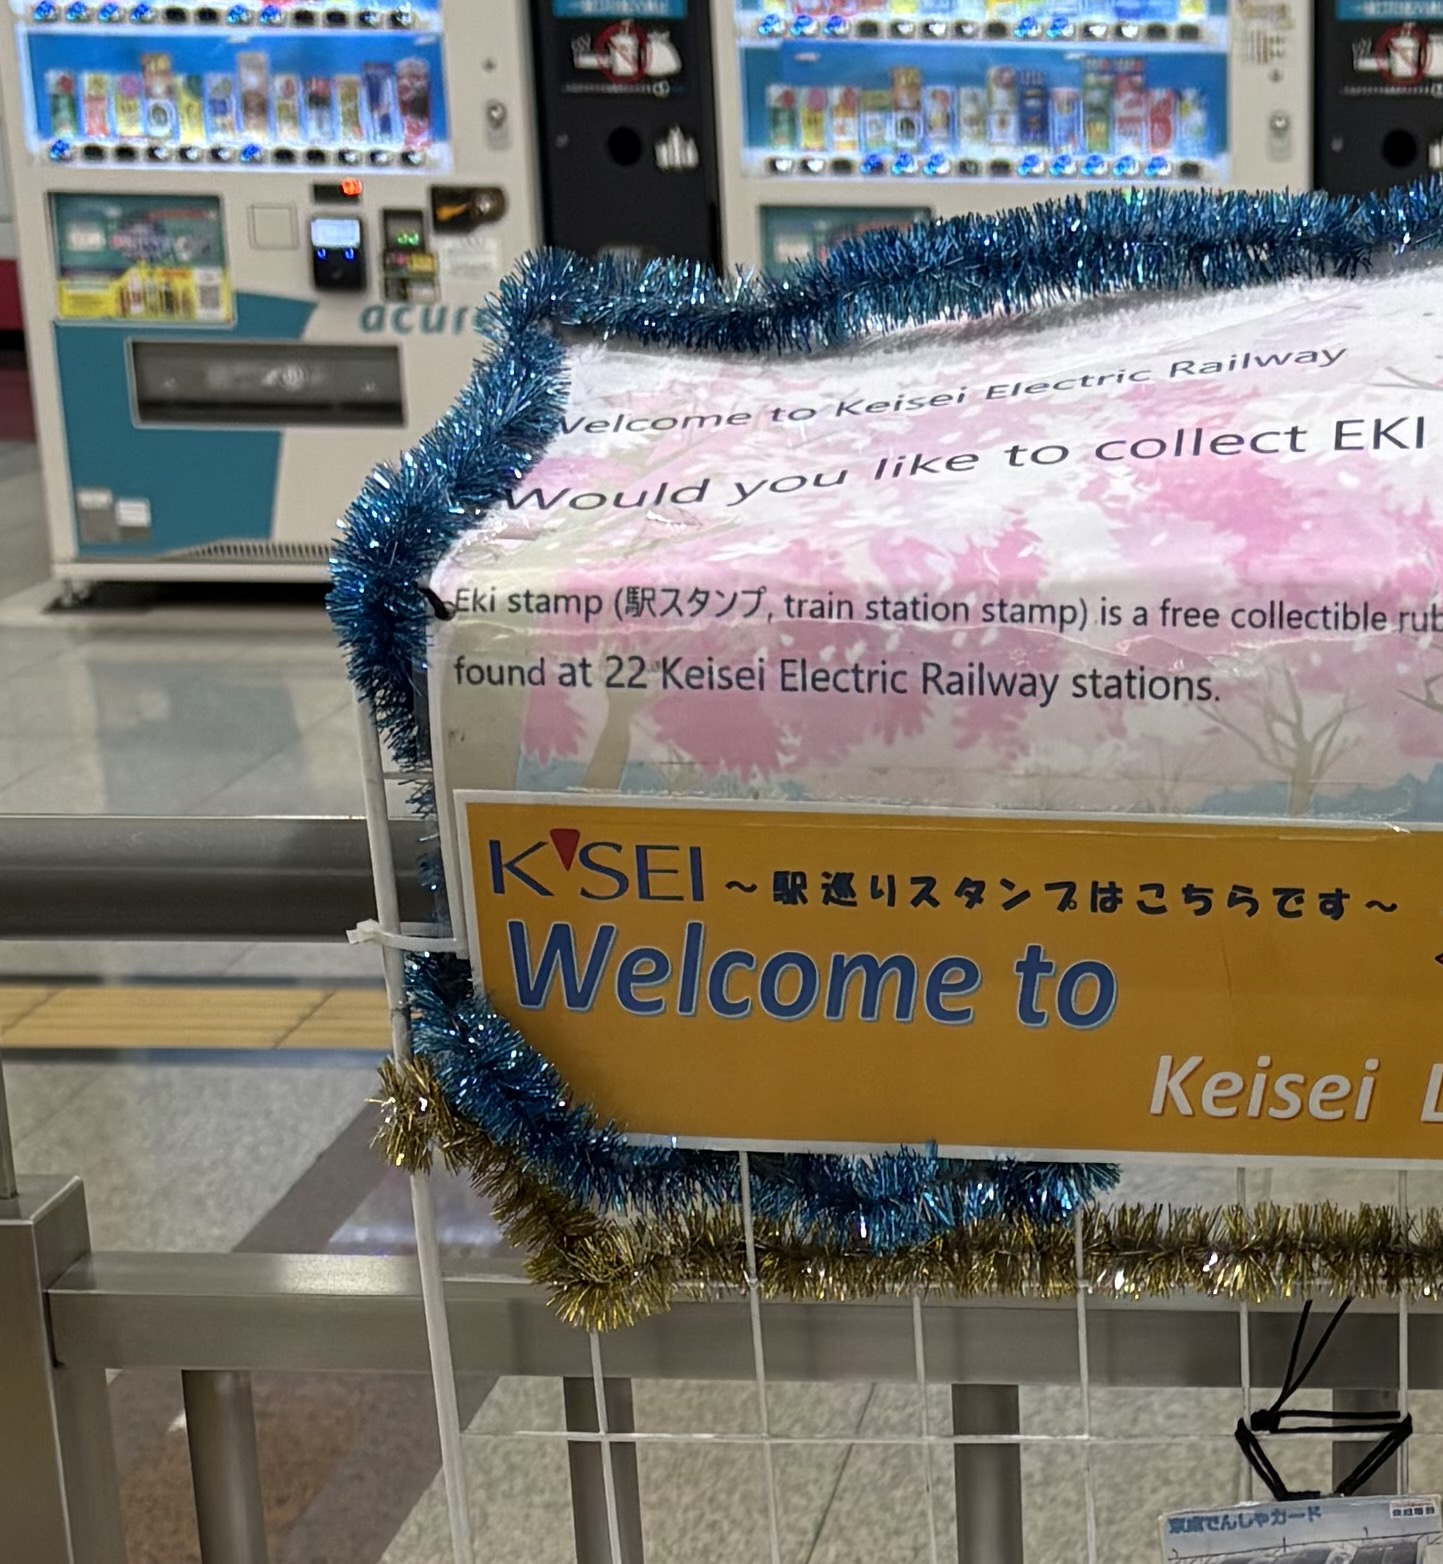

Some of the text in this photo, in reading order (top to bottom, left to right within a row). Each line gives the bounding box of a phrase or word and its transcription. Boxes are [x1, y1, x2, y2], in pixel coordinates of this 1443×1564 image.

[771, 406, 816, 422] to
[835, 386, 967, 417] Keisei
[985, 368, 1153, 400] Electric
[1169, 348, 1347, 378] Railway
[506, 478, 710, 510] Would
[727, 470, 848, 507] you
[874, 453, 979, 480] like
[1004, 445, 1069, 467] to
[1095, 425, 1308, 461] collect
[1334, 416, 1425, 451] EKI
[456, 586, 496, 612] Eki
[508, 589, 602, 623] stamp
[784, 593, 854, 620] train
[865, 597, 969, 622] station
[981, 598, 1088, 632] stamp)
[1101, 597, 1121, 625] is
[1133, 605, 1148, 626] a
[1160, 599, 1219, 627] free
[1231, 599, 1386, 631] collectible
[455, 656, 1220, 706] found at 22 Keisei Electric Railway stations.
[507, 919, 1117, 1029] Welcome to
[1150, 1054, 1380, 1120] Keisei
